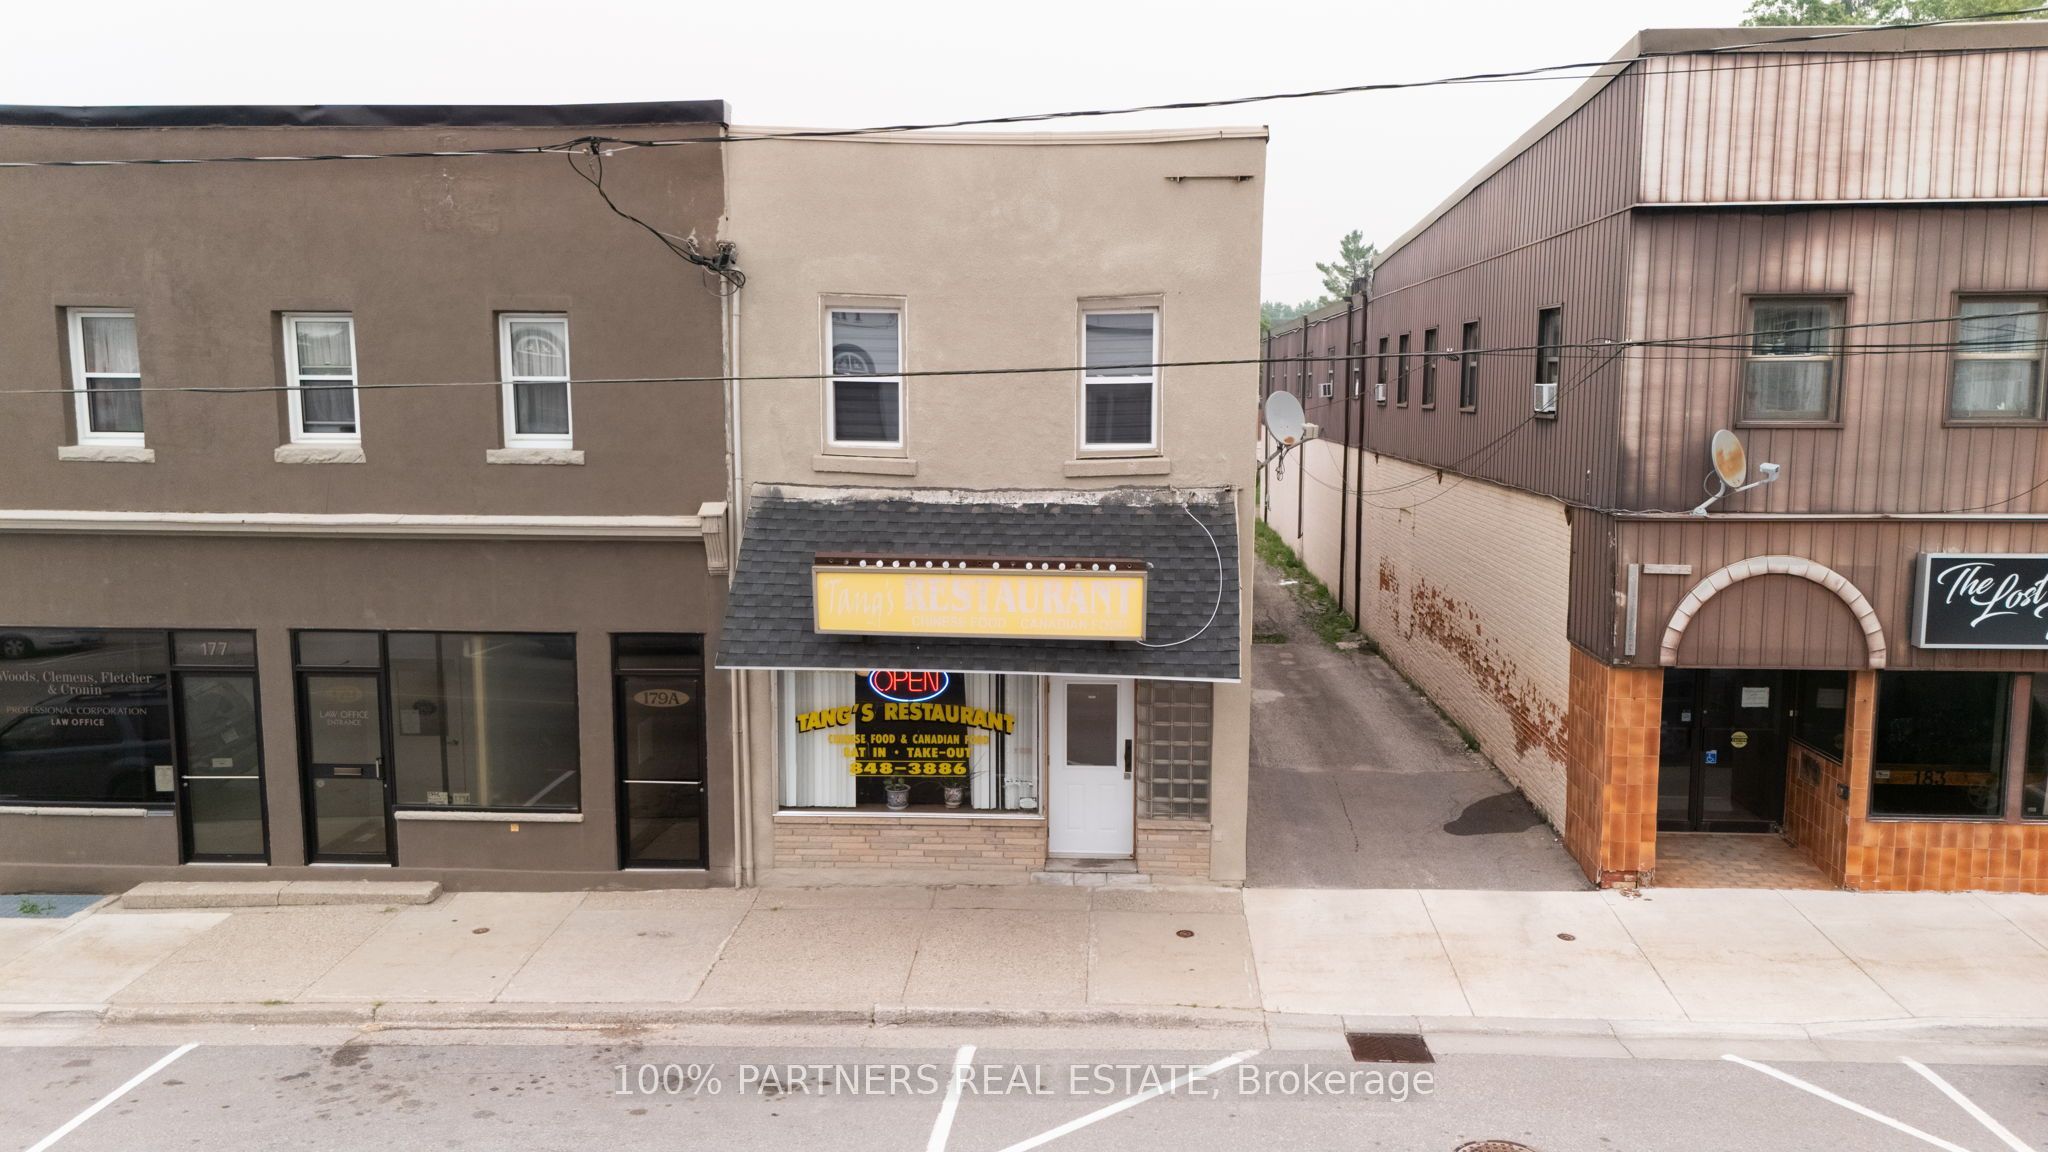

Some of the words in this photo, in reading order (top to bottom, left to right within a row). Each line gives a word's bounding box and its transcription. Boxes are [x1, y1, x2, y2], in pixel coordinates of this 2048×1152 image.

[823, 577, 894, 627] Tang's
[903, 576, 1138, 616] RESTAURANT
[1937, 562, 1995, 604] The
[1970, 573, 2048, 628] Lost
[200, 642, 228, 656] 177
[0, 671, 39, 684] Woods,
[43, 671, 98, 685] Clemens,
[101, 672, 152, 684] Fletcher
[874, 671, 939, 692] OPEN
[47, 685, 57, 695] &
[61, 684, 102, 696] Cronin
[643, 690, 680, 705] 179A
[6, 706, 73, 715] PROFESSIONAL
[76, 707, 147, 716] CORPORATION
[320, 710, 337, 719] LAW
[340, 710, 368, 719] OFFICE
[51, 718, 69, 726] LAW
[72, 719, 104, 727] OFFICE
[796, 703, 875, 732] TANG'S
[884, 703, 1016, 735] RESTAURANT
[829, 734, 866, 745] CESE
[871, 734, 896, 745] FOOD
[901, 734, 908, 745] &
[912, 734, 960, 745] CANADIAN
[873, 747, 886, 758] IN
[907, 747, 971, 758] TAKE-OUT
[849, 762, 967, 775] 848-3886
